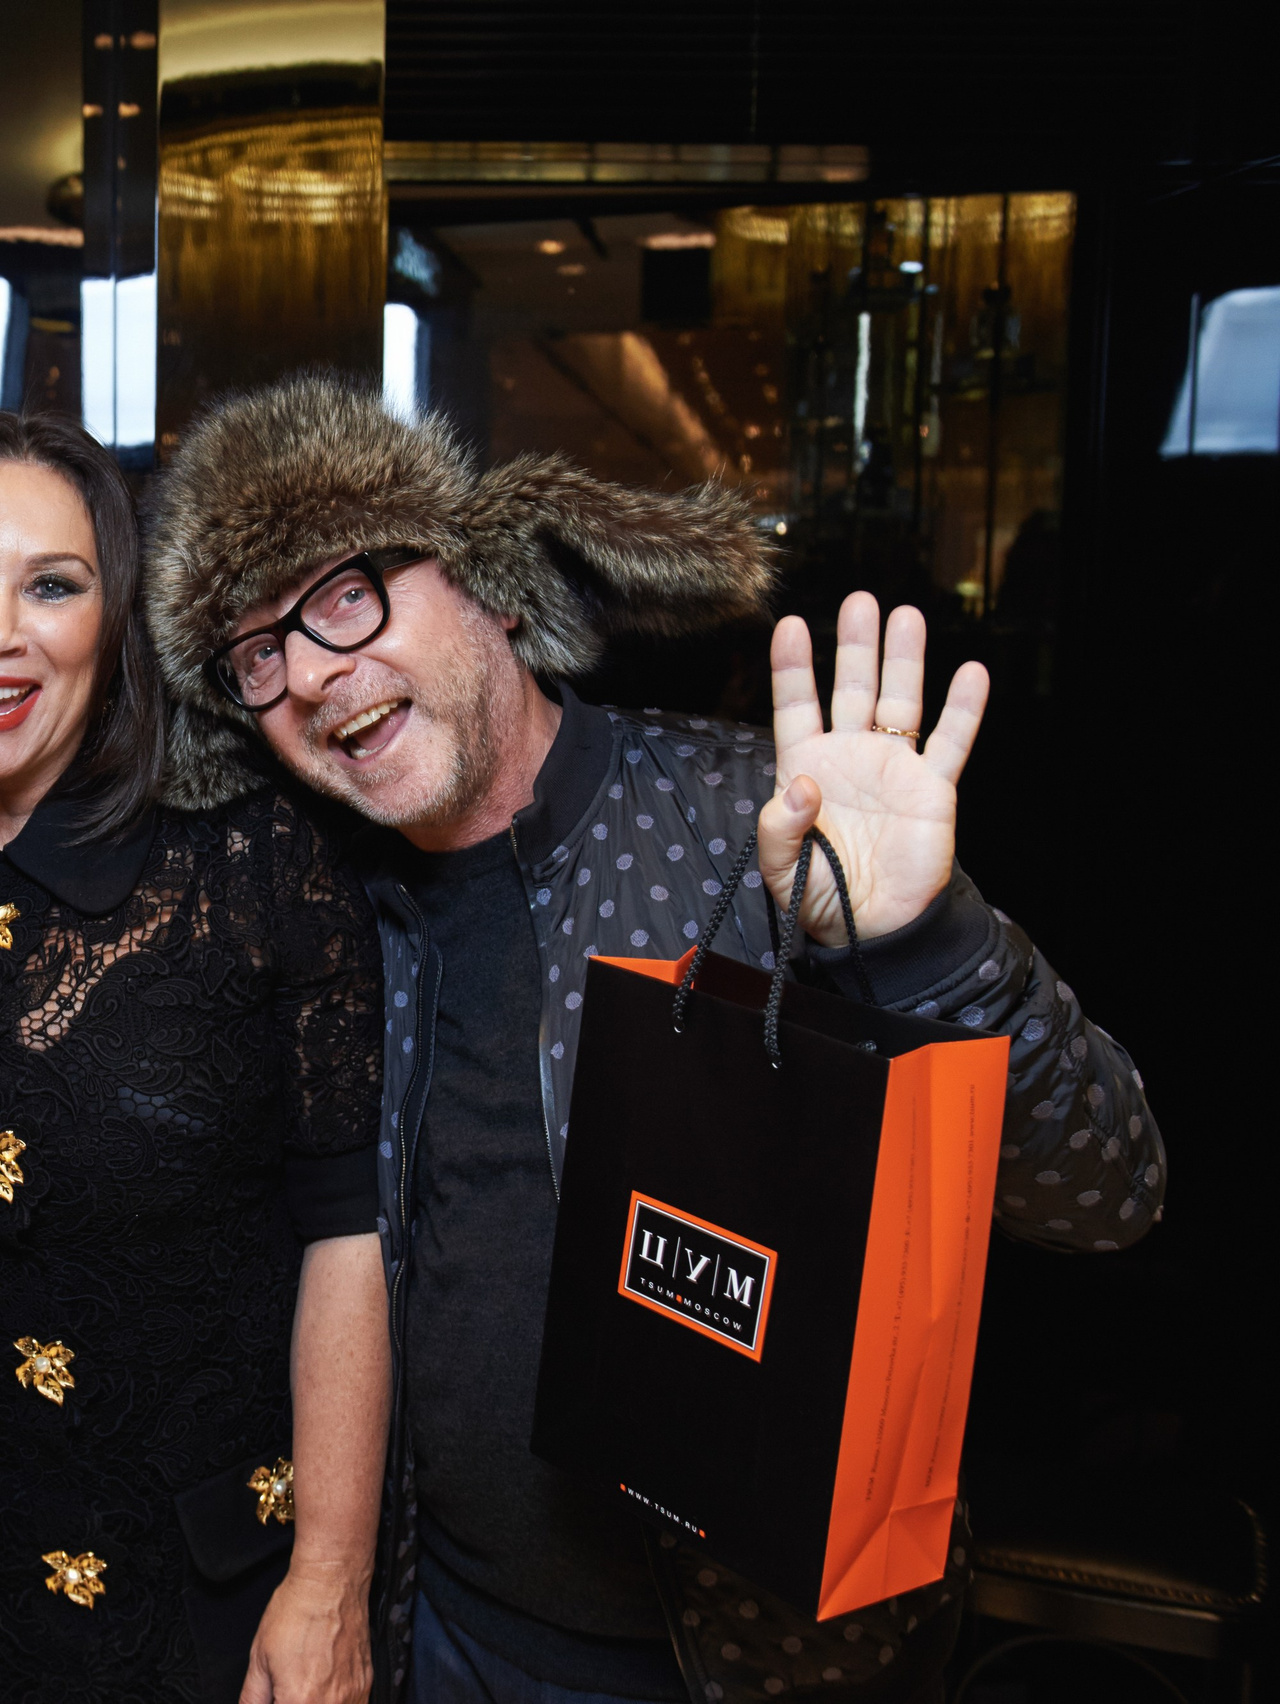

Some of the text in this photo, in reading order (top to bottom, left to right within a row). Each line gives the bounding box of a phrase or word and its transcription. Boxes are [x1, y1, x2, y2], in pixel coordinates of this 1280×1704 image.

[640, 1277, 742, 1331] TSUM MOSCOW
[627, 1488, 697, 1532] WWW.TSUM.RU
